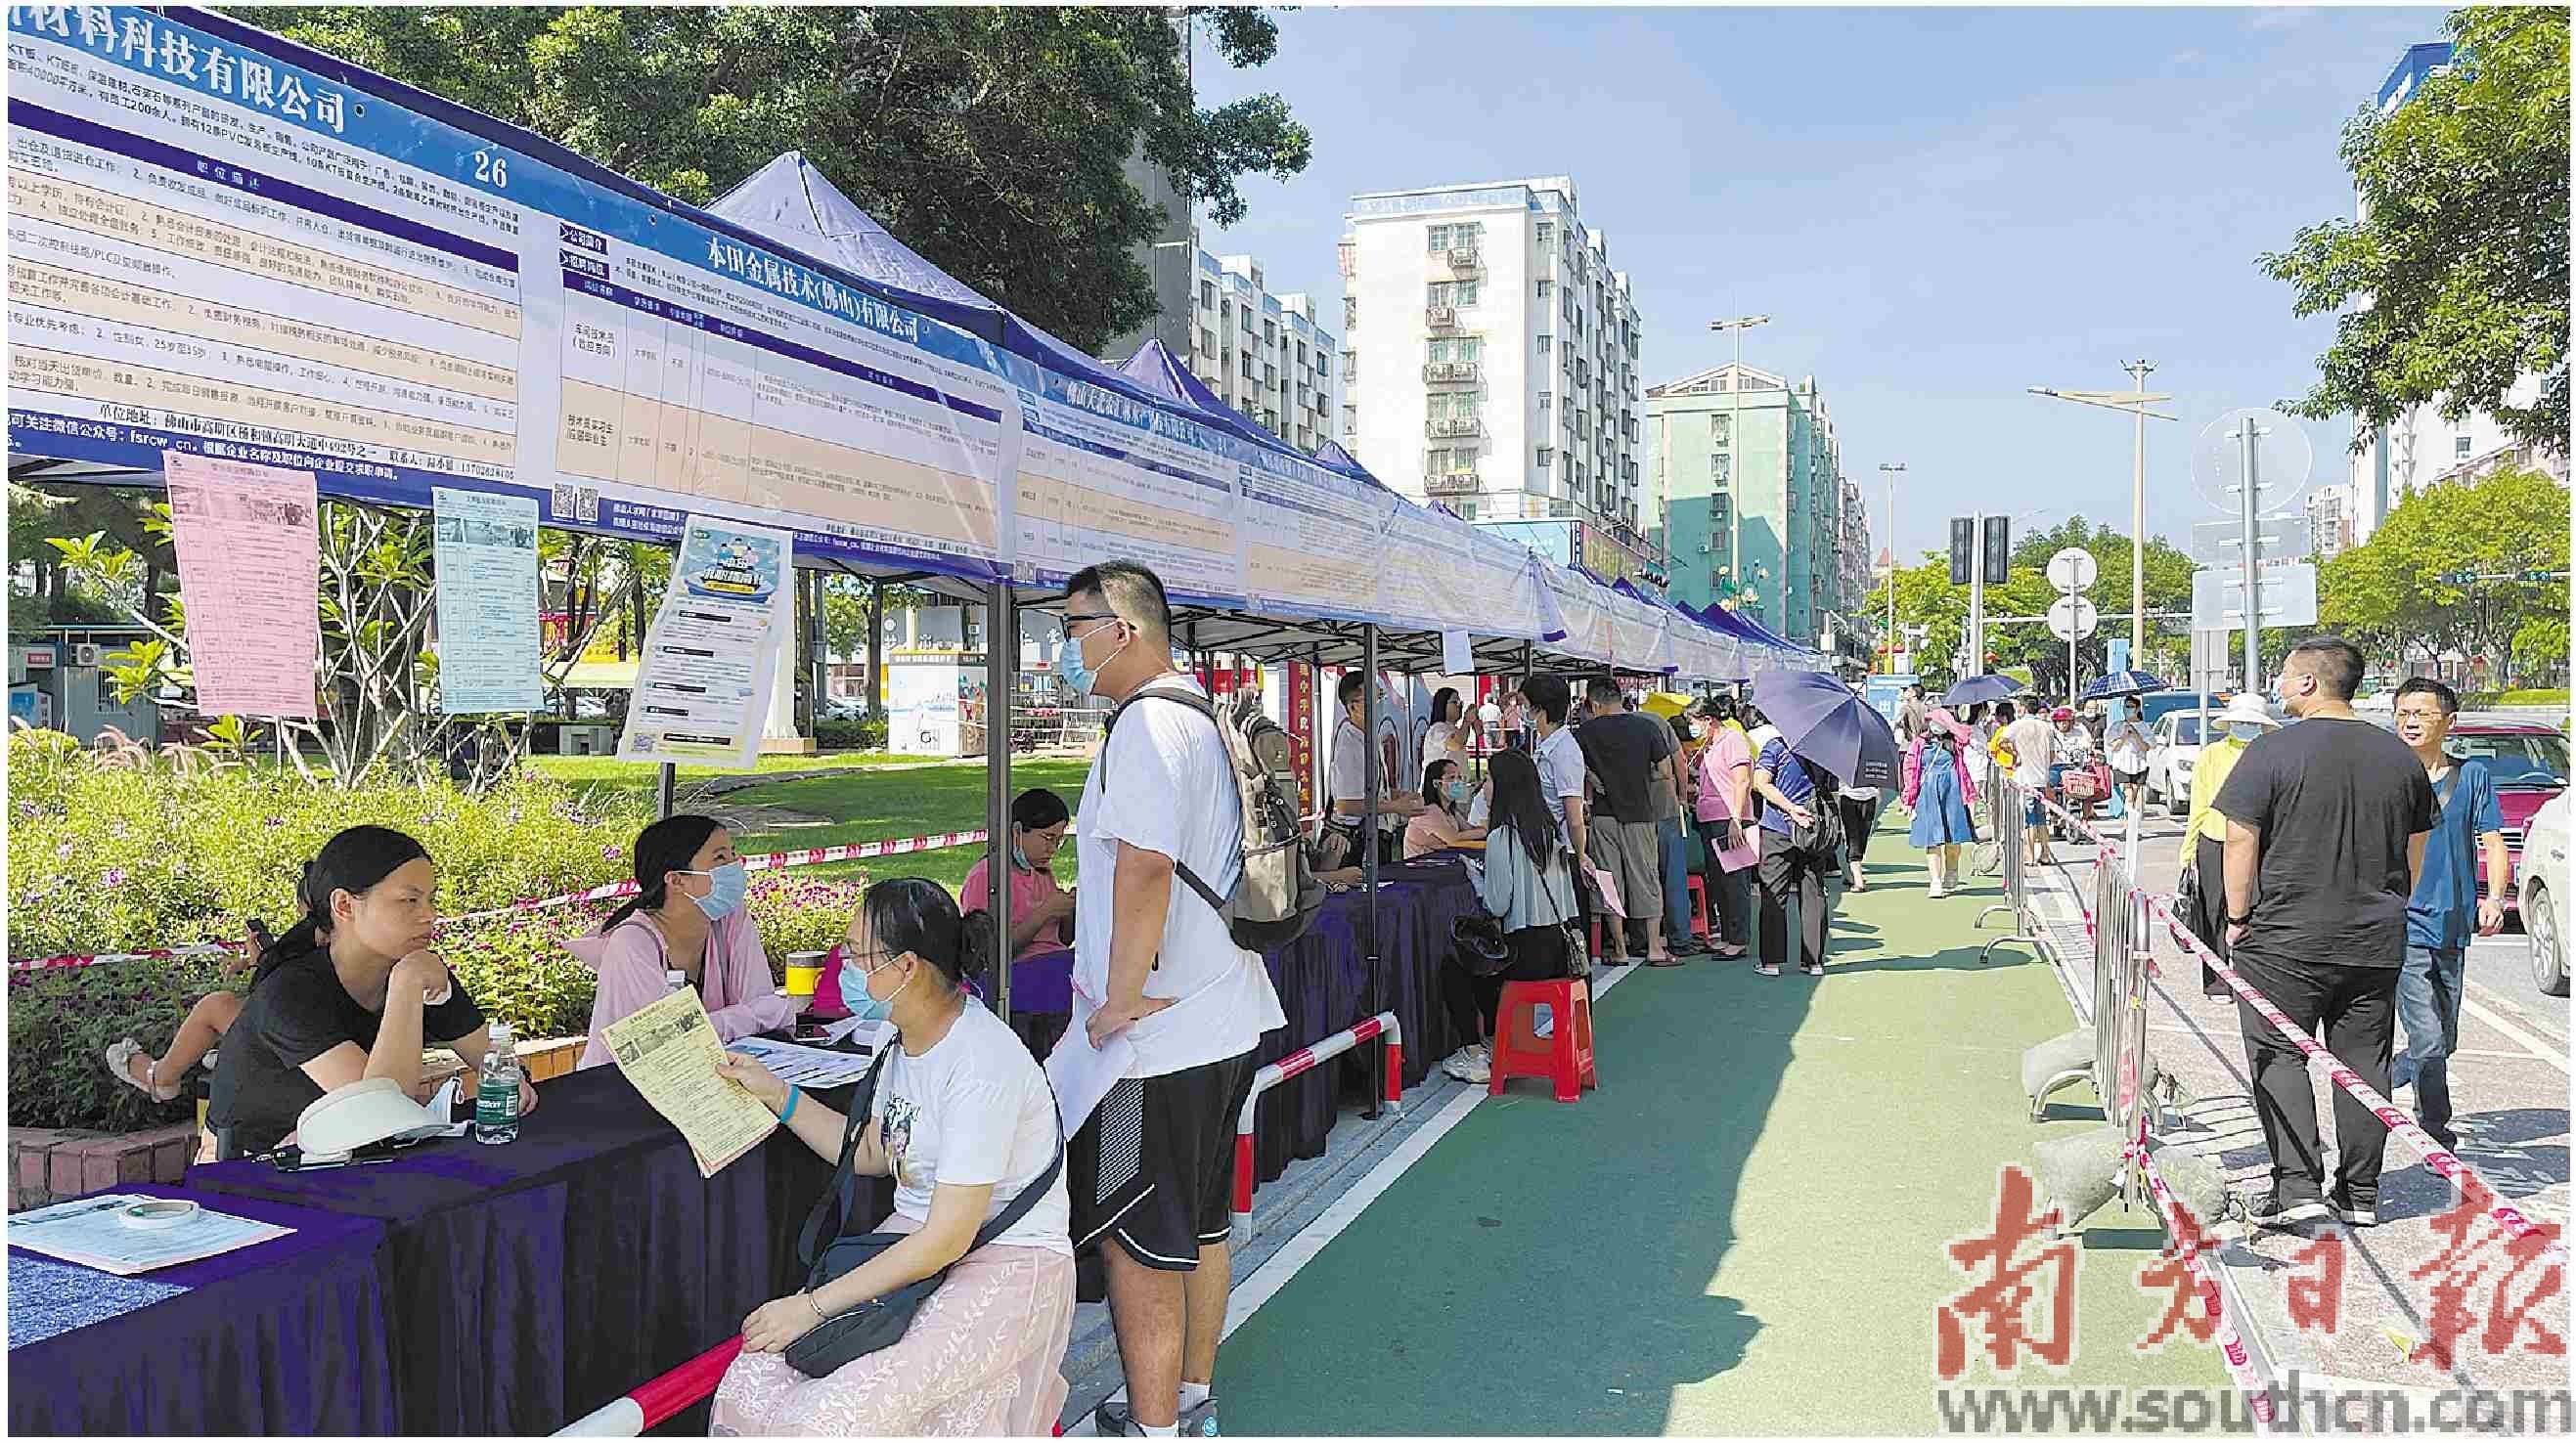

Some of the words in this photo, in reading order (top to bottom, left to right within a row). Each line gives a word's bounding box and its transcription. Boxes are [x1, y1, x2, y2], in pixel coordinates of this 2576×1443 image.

[474, 151, 507, 189] 26
[706, 236, 918, 342] 本田金属技术(佛山)有限公司
